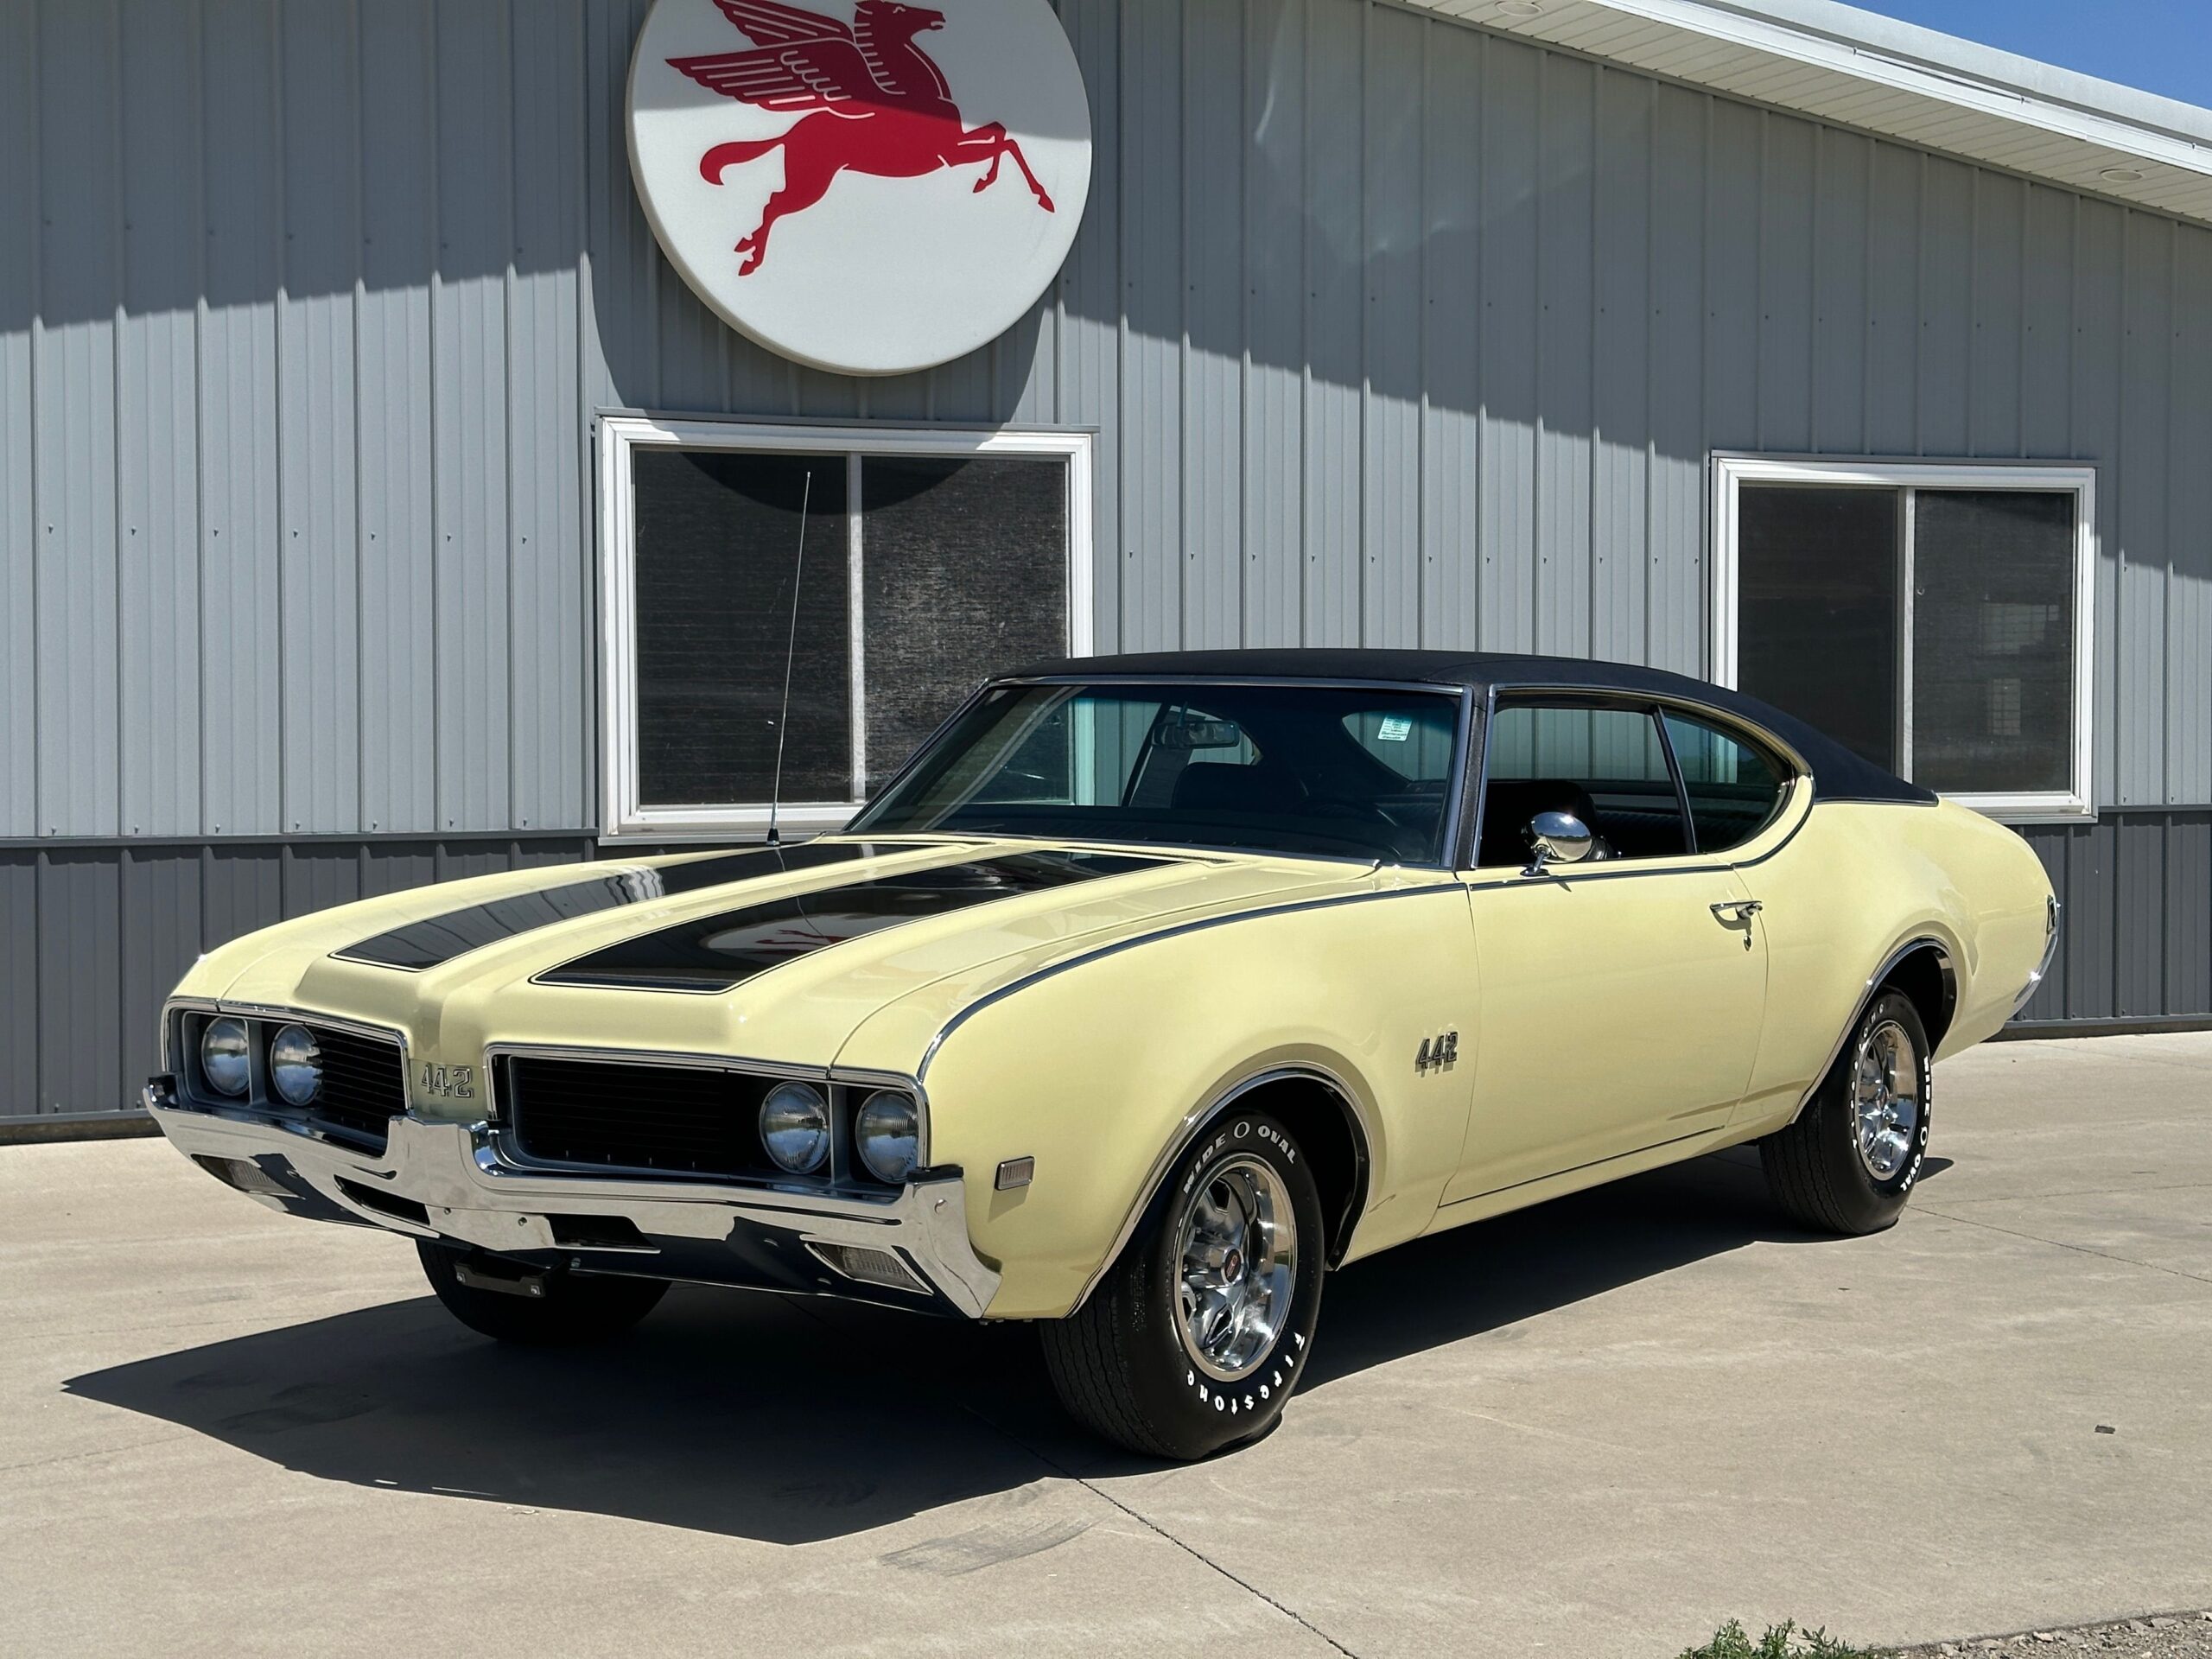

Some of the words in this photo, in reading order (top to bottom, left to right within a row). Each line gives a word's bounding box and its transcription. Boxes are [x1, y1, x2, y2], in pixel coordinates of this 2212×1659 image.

[1414, 1031, 1458, 1070] 442
[421, 1063, 474, 1099] 442
[1183, 1133, 1227, 1194] WIDE
[1257, 1125, 1296, 1165] OVAL
[1900, 1154, 1922, 1192] OVAL
[1187, 1332, 1306, 1415] Firestone
